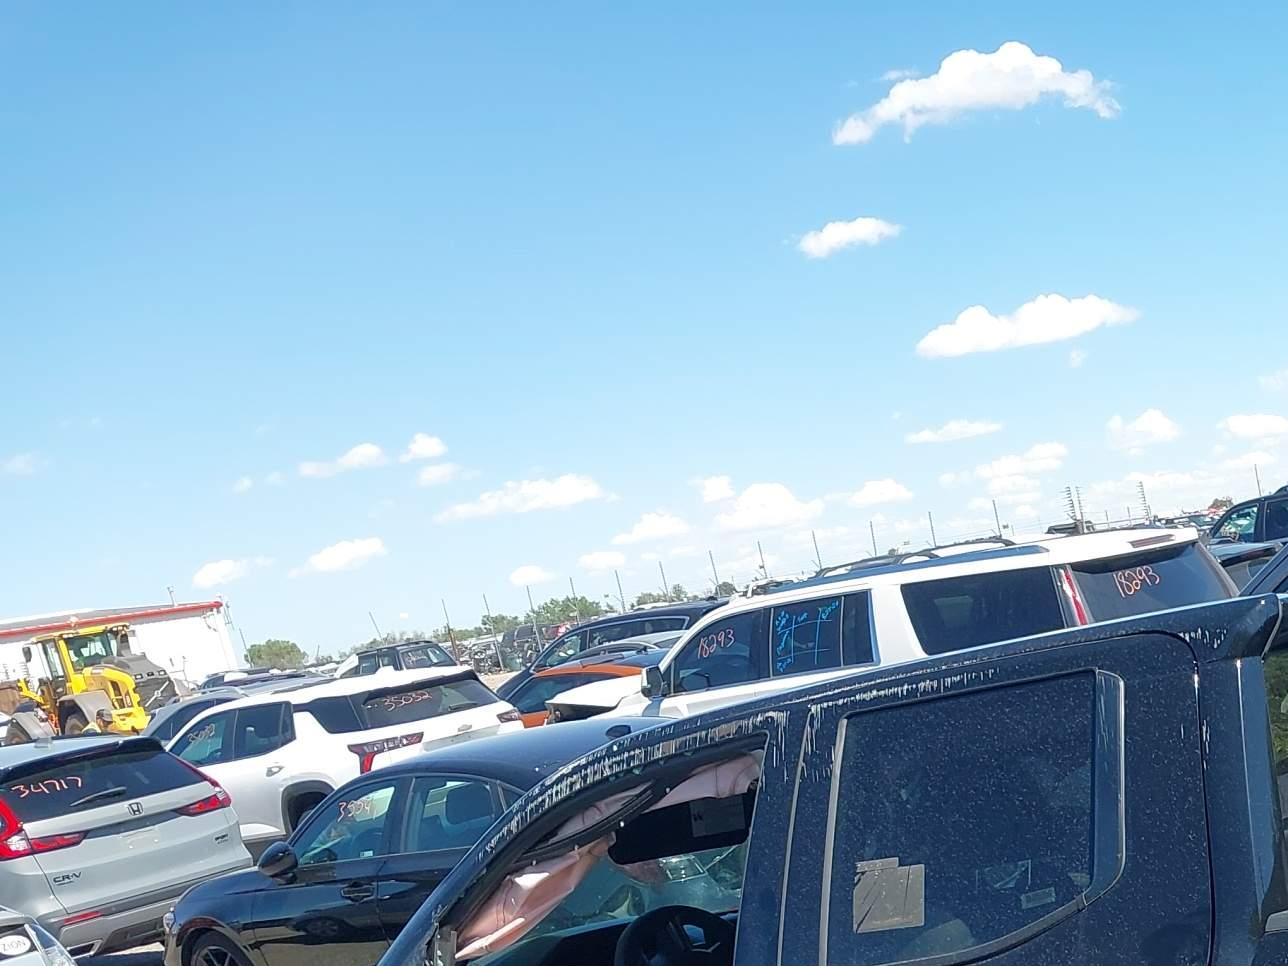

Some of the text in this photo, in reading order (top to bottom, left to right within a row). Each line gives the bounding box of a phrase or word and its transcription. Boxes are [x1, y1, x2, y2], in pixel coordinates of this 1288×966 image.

[1112, 565, 1160, 598] 18293
[698, 628, 735, 659] 18293
[11, 776, 82, 798] 34717
[53, 871, 82, 883] CR-V
